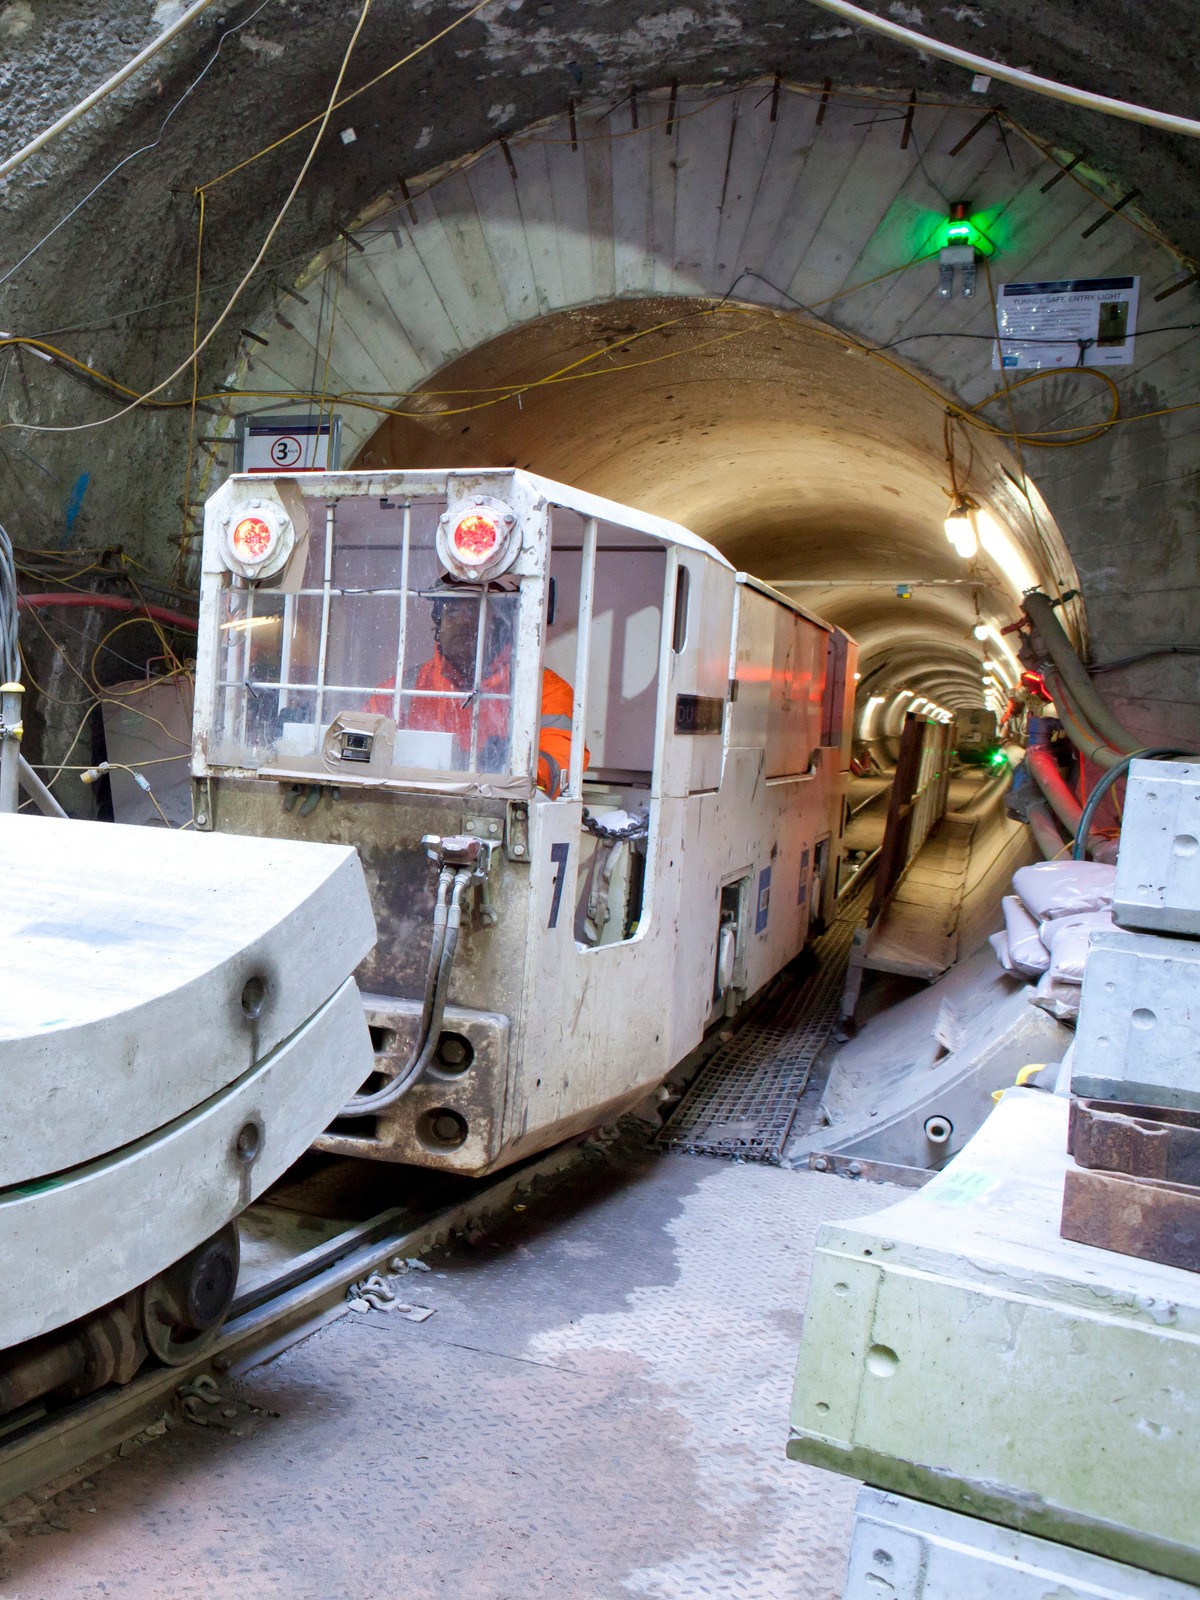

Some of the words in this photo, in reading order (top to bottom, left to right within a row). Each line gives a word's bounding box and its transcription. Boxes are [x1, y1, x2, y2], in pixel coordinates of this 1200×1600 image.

[1013, 297, 1044, 305] TUNNEL
[1069, 294, 1096, 302] ENTRY
[1097, 292, 1122, 301] LIGHT
[277, 442, 288, 460] 3
